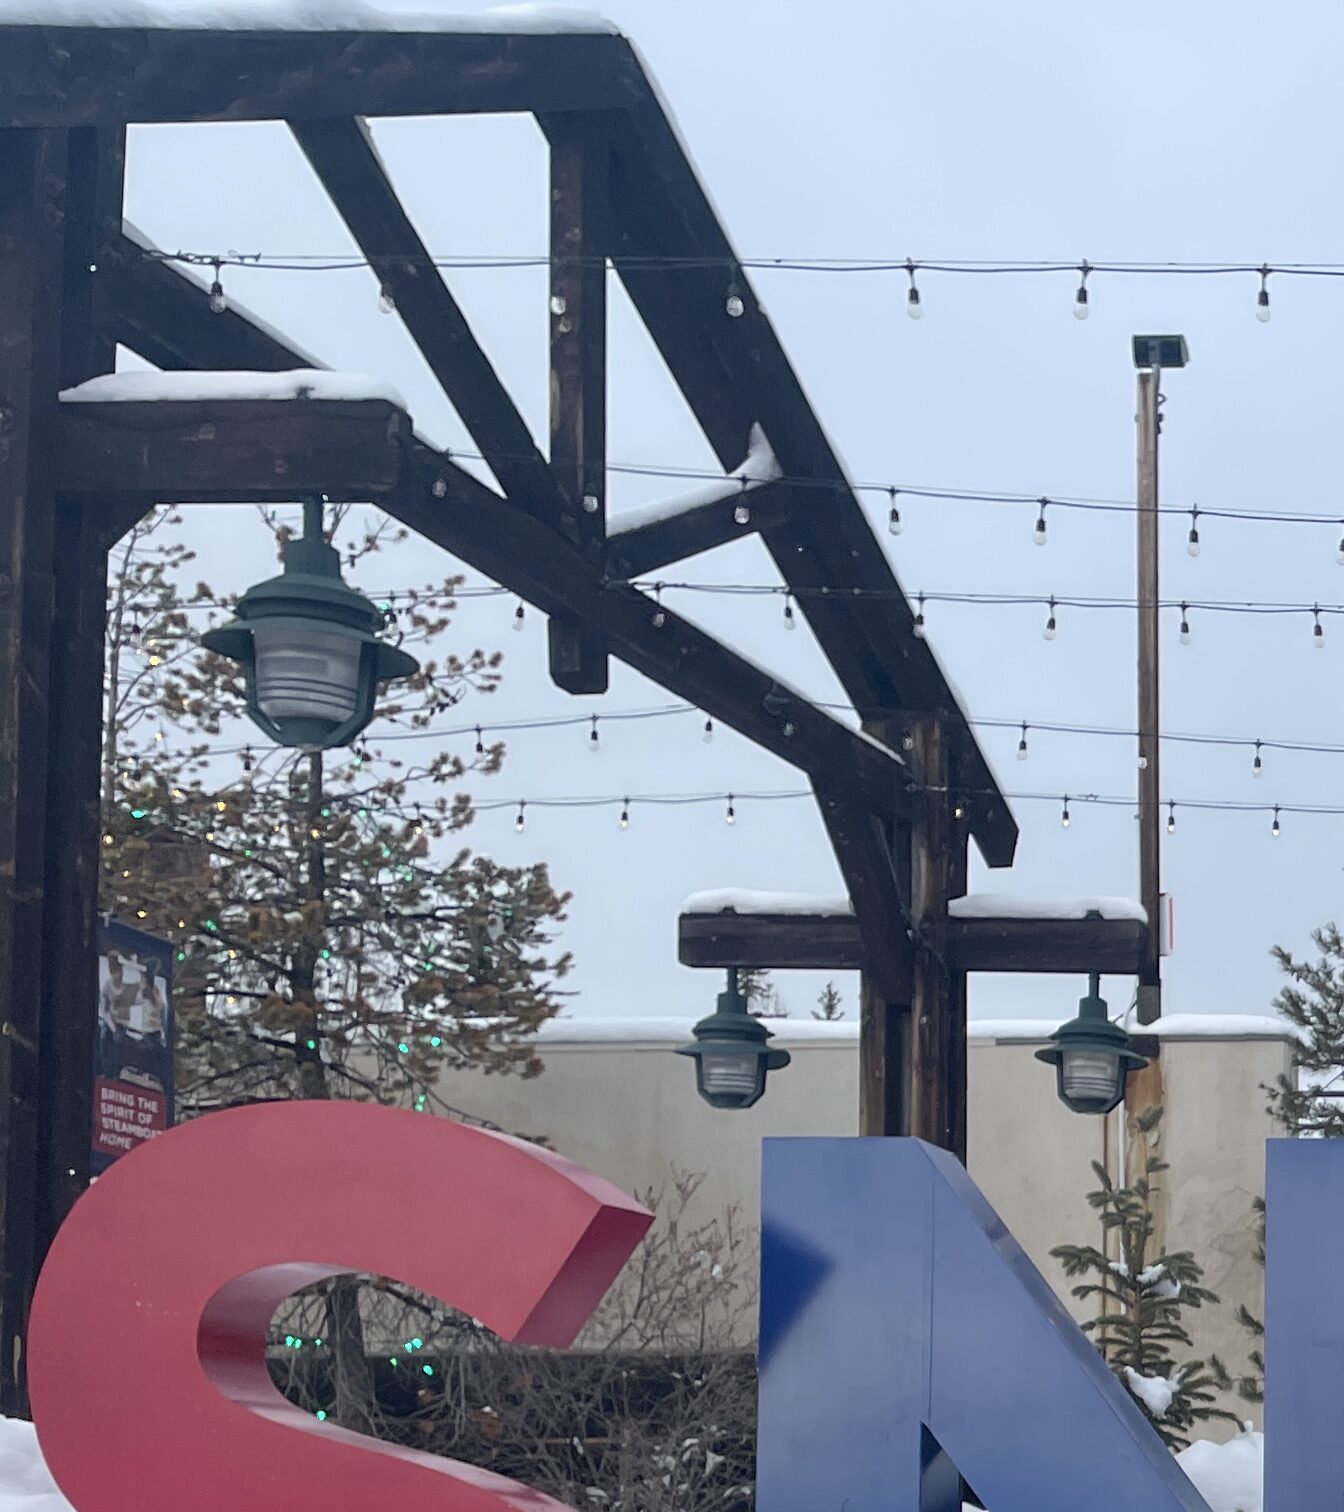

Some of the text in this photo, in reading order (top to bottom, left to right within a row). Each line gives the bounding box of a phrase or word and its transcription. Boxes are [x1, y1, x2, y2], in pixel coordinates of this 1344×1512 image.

[101, 1087, 158, 1114] BRING THE
[100, 1102, 153, 1125] SPIRIT OF
[99, 1131, 132, 1150] HOME
